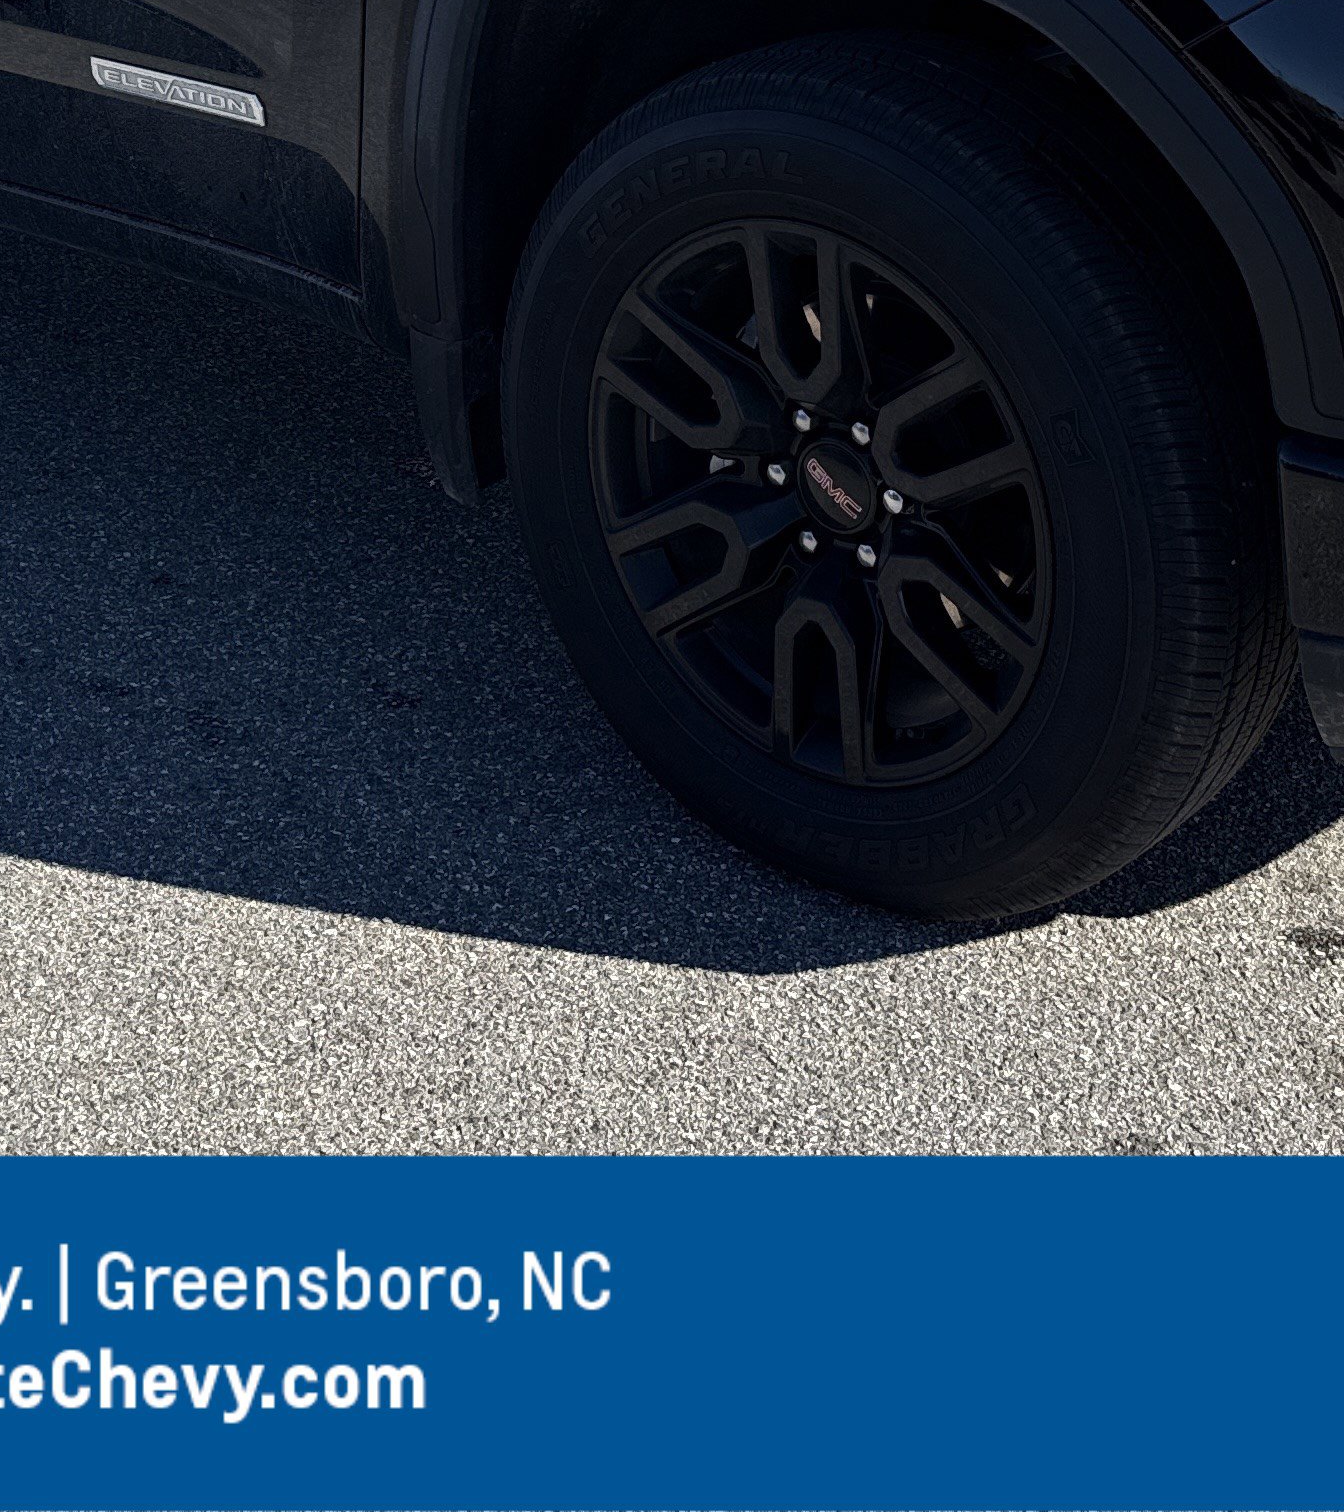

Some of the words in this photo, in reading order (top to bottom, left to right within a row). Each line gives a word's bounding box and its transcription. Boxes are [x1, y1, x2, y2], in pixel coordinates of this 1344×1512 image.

[104, 69, 249, 115] ELEVATION
[577, 147, 805, 259] GENERAL
[807, 458, 862, 520] GMC
